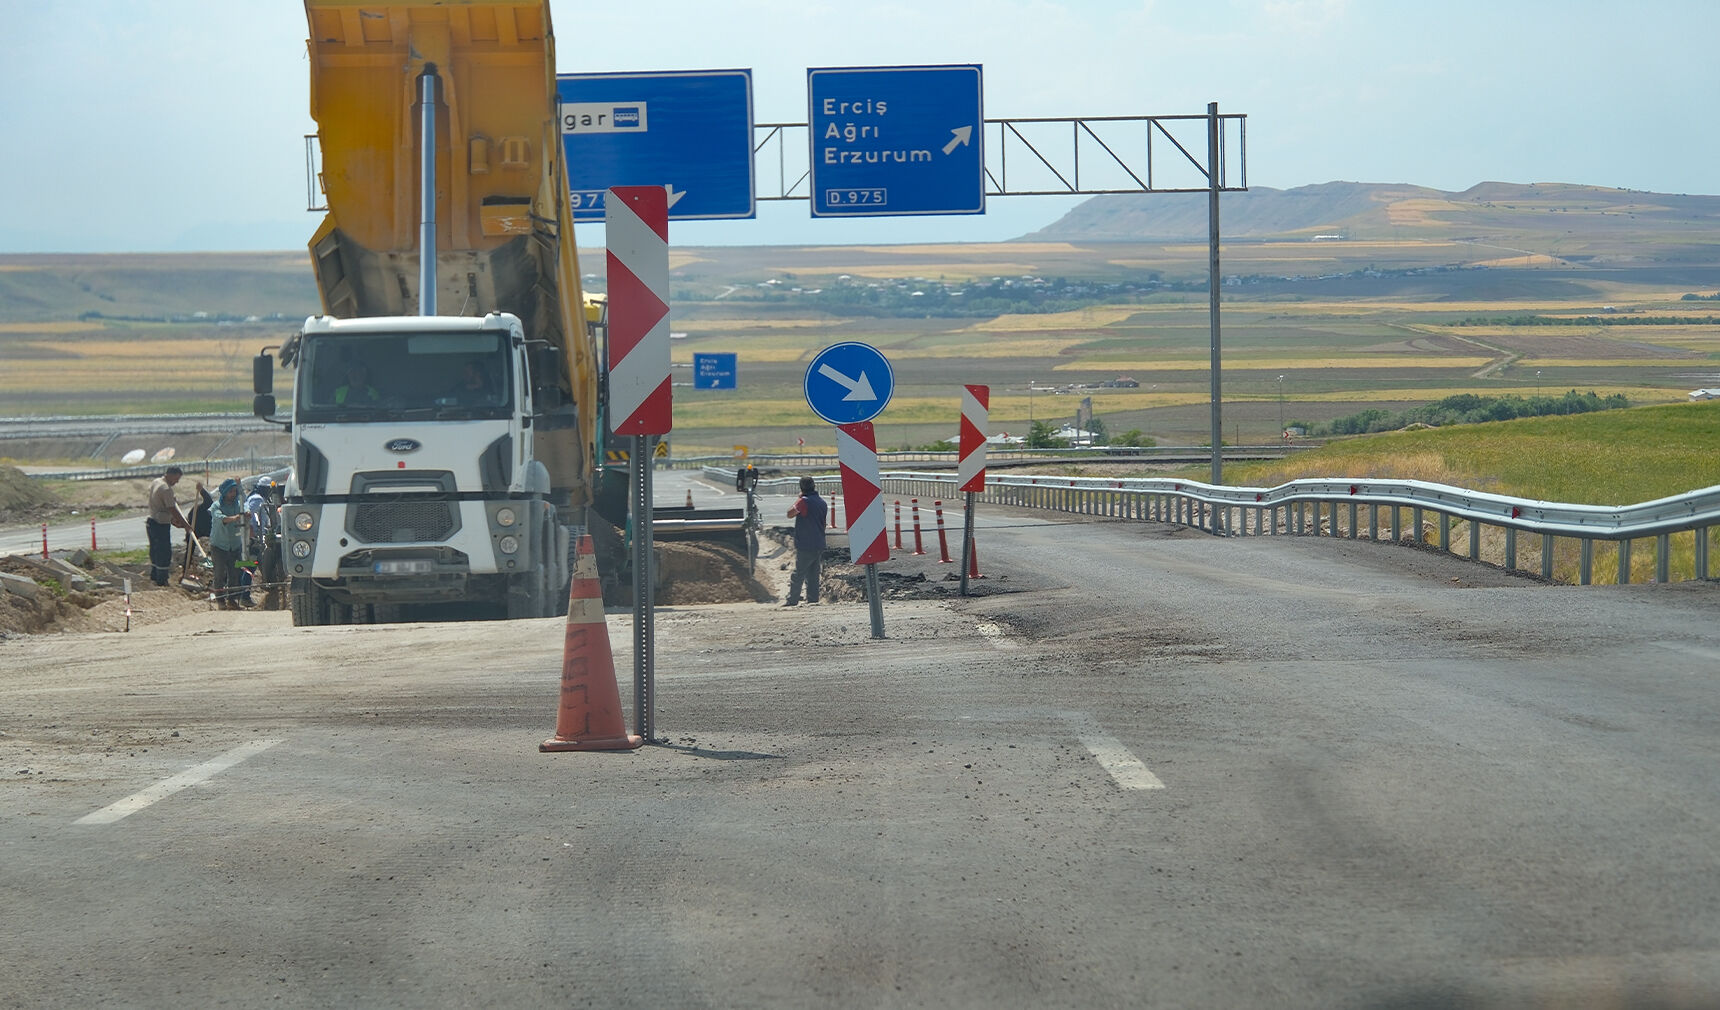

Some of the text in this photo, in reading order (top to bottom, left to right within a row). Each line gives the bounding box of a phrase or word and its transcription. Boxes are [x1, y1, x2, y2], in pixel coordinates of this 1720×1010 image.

[823, 98, 887, 116] Erciş
[824, 122, 879, 143] Ağrı
[824, 147, 932, 164] Erzurum
[570, 193, 606, 208] 97
[830, 192, 883, 204] D.975
[391, 440, 414, 450] Ford
